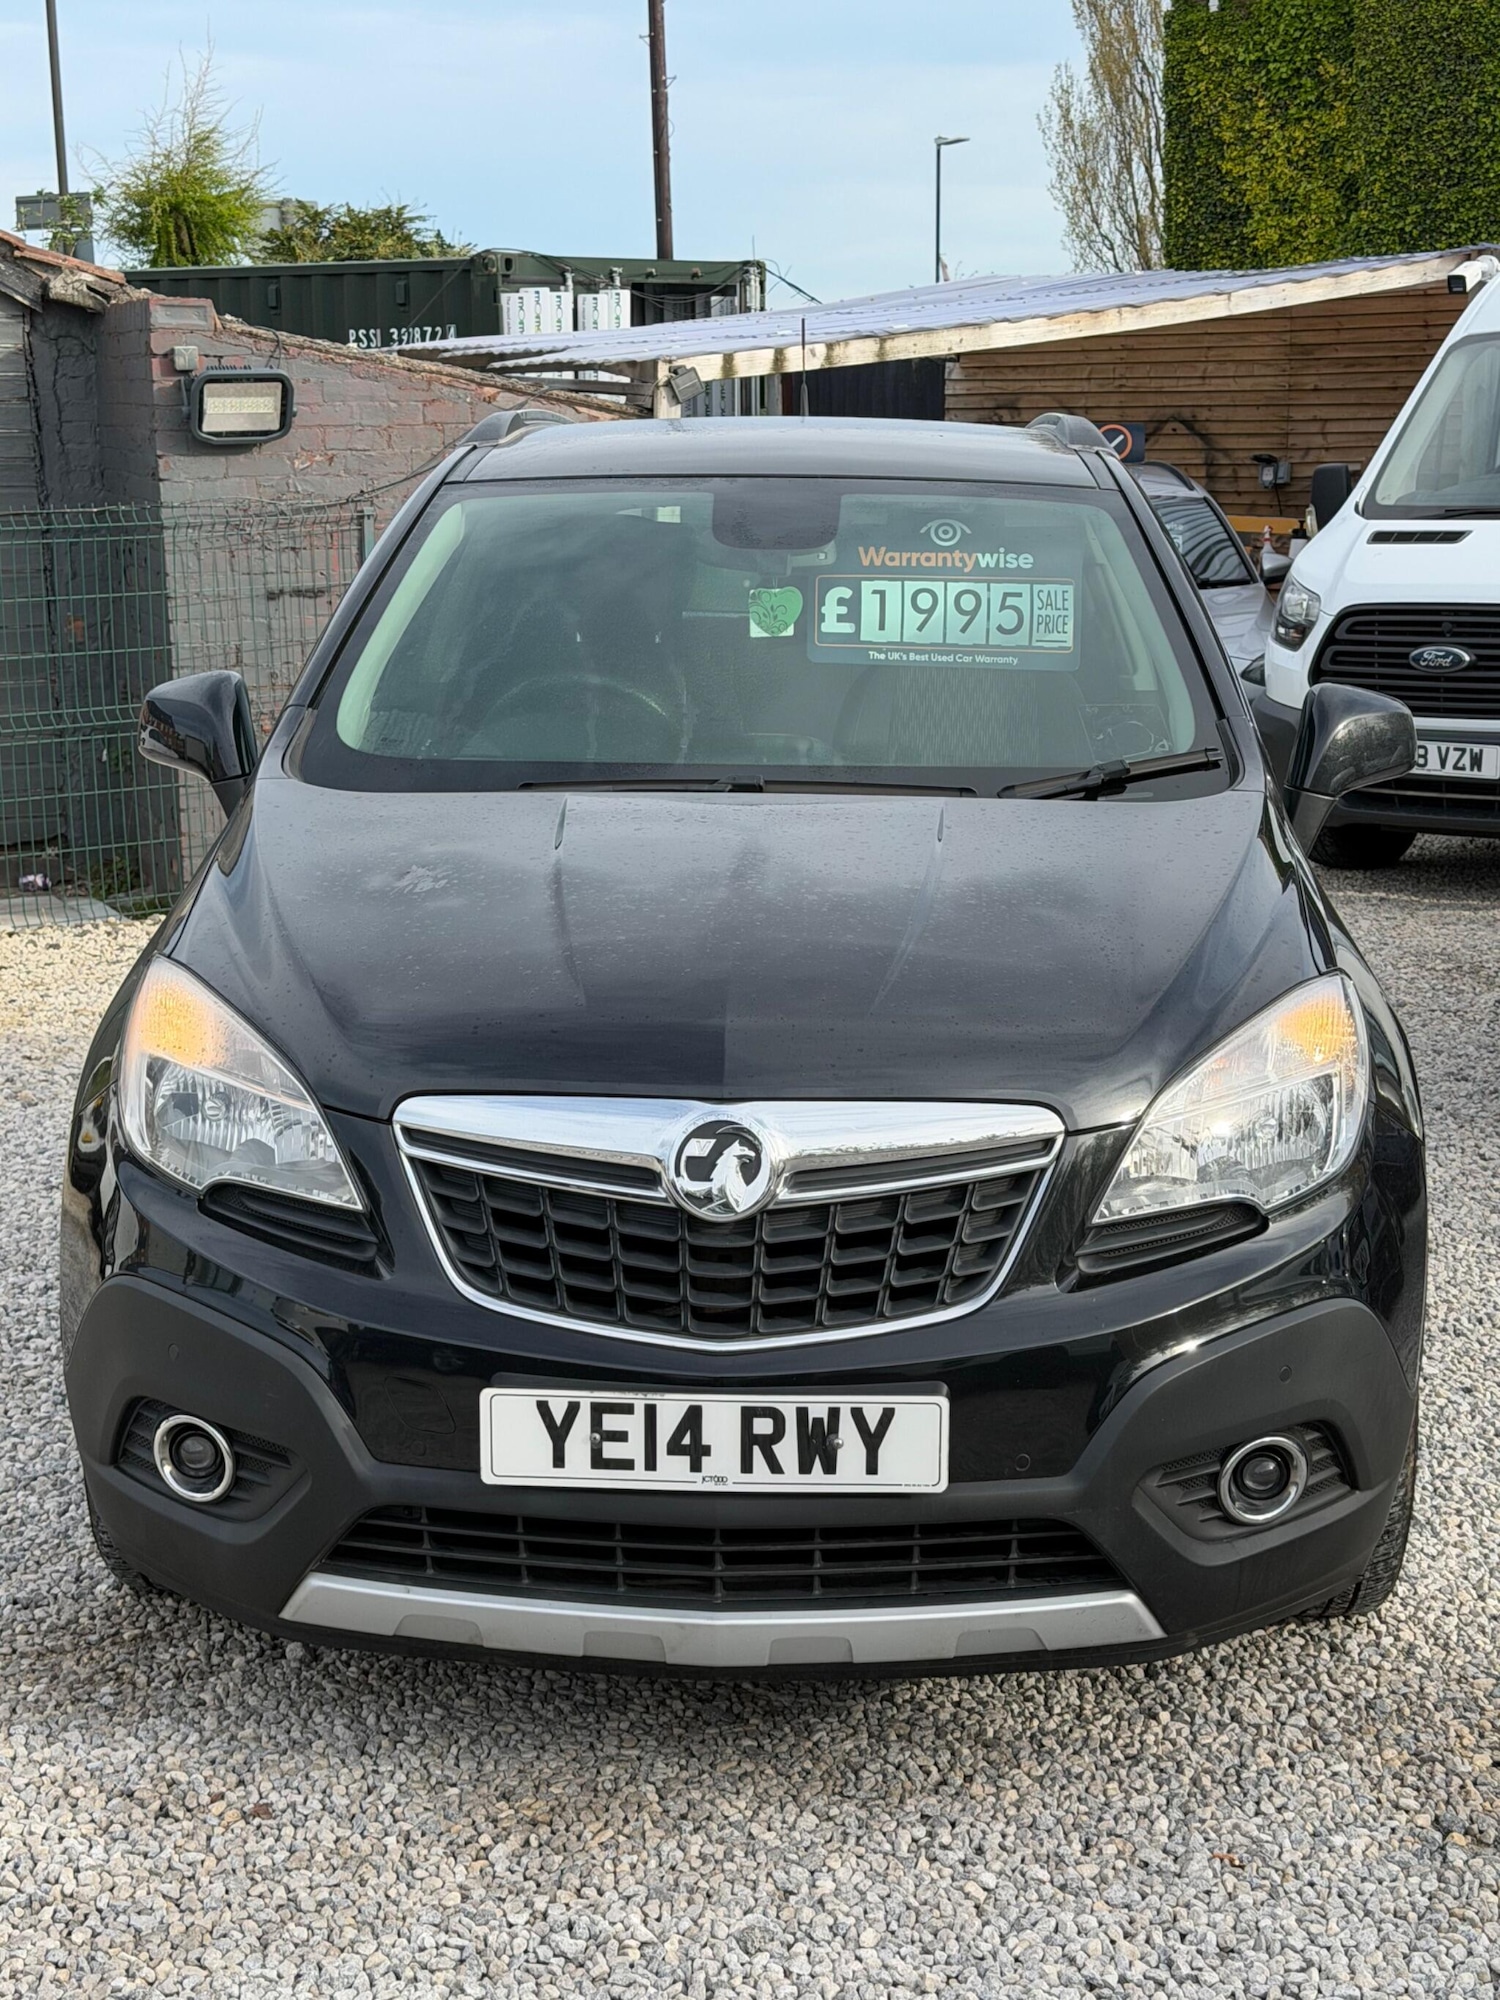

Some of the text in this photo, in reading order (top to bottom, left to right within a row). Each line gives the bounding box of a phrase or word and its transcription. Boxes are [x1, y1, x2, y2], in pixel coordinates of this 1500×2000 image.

[857, 545, 1035, 573] Warrantywise
[1036, 589, 1069, 612] SALE
[1036, 613, 1069, 635] PRICE
[868, 650, 1019, 666] The UK's Best Used Car Warranty
[1419, 650, 1452, 668] Ford
[1436, 745, 1484, 773] VZW
[536, 1399, 896, 1475] YE14 RWY
